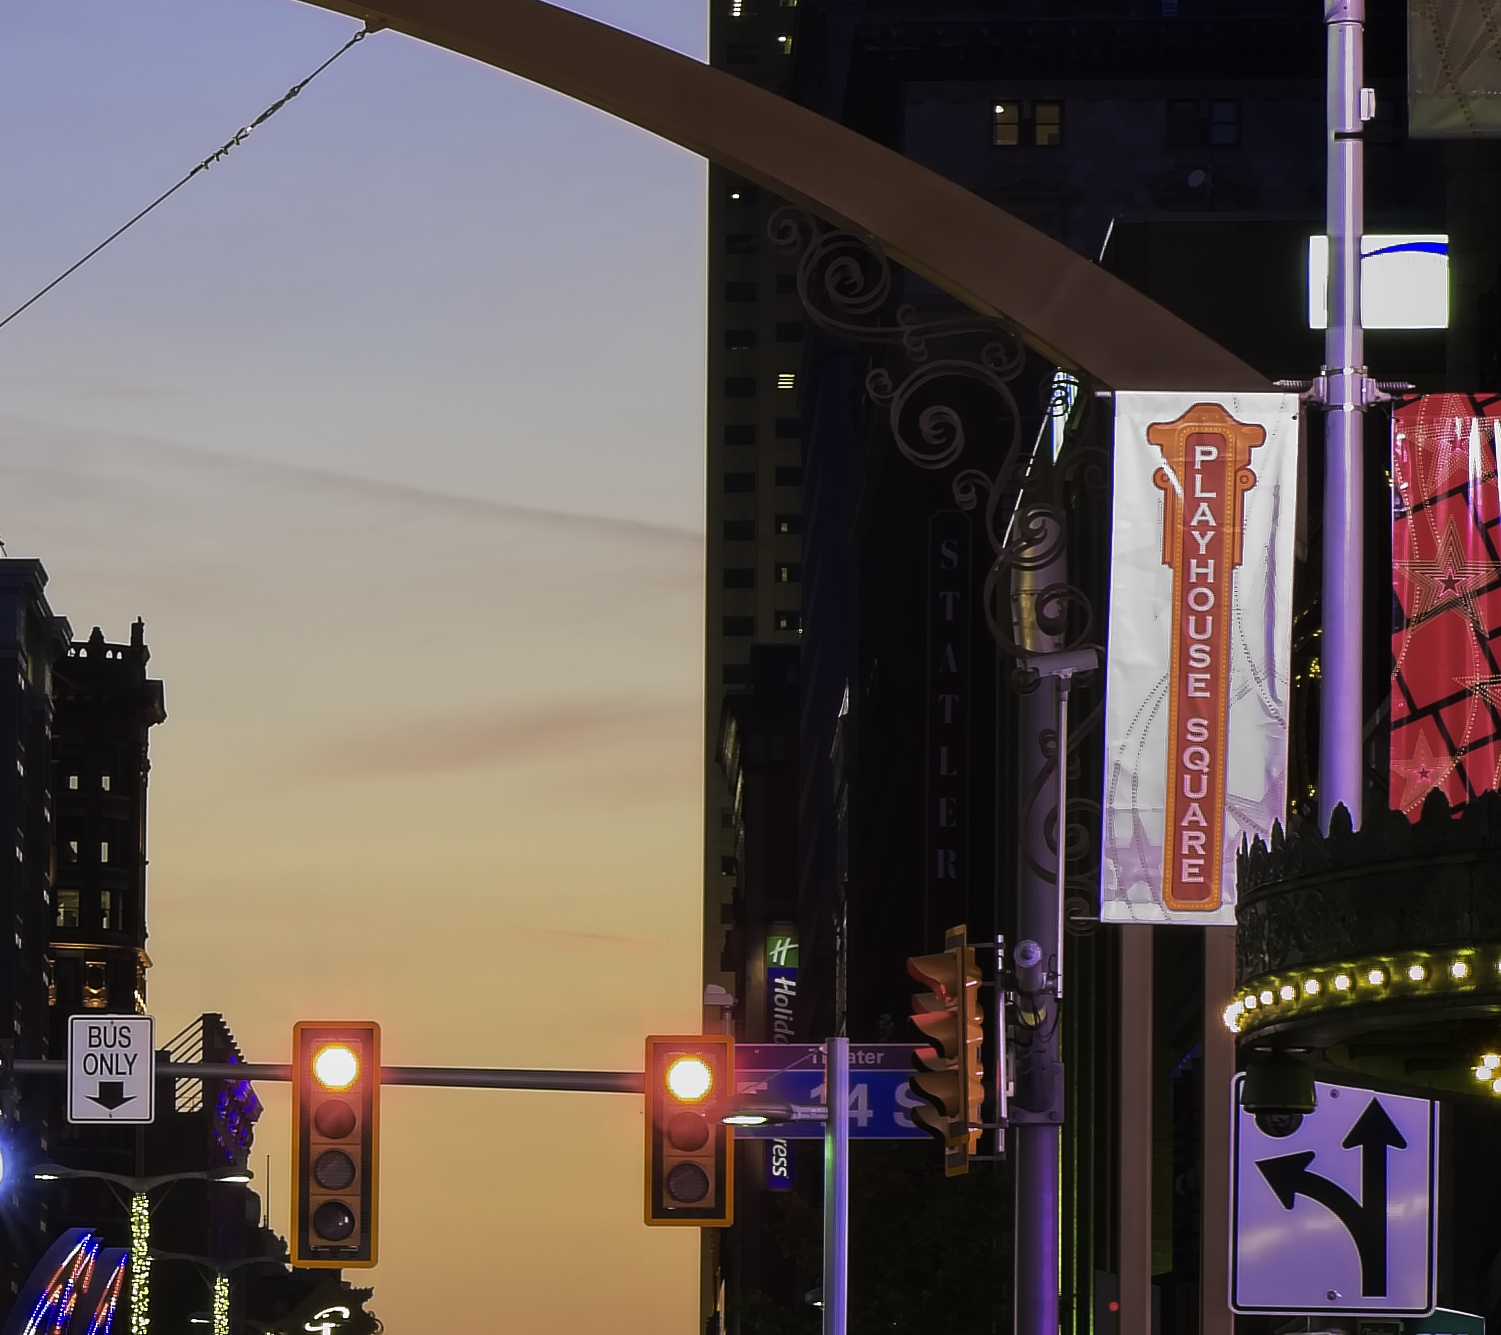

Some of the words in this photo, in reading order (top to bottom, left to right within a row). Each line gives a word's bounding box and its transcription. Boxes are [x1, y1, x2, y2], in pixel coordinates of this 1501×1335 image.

[1187, 444, 1217, 699] PLAYHOUSE
[936, 538, 961, 881] STATLER
[1181, 717, 1211, 884] SQUARE
[82, 1052, 139, 1076] ONLY
[87, 1025, 132, 1049] BUS
